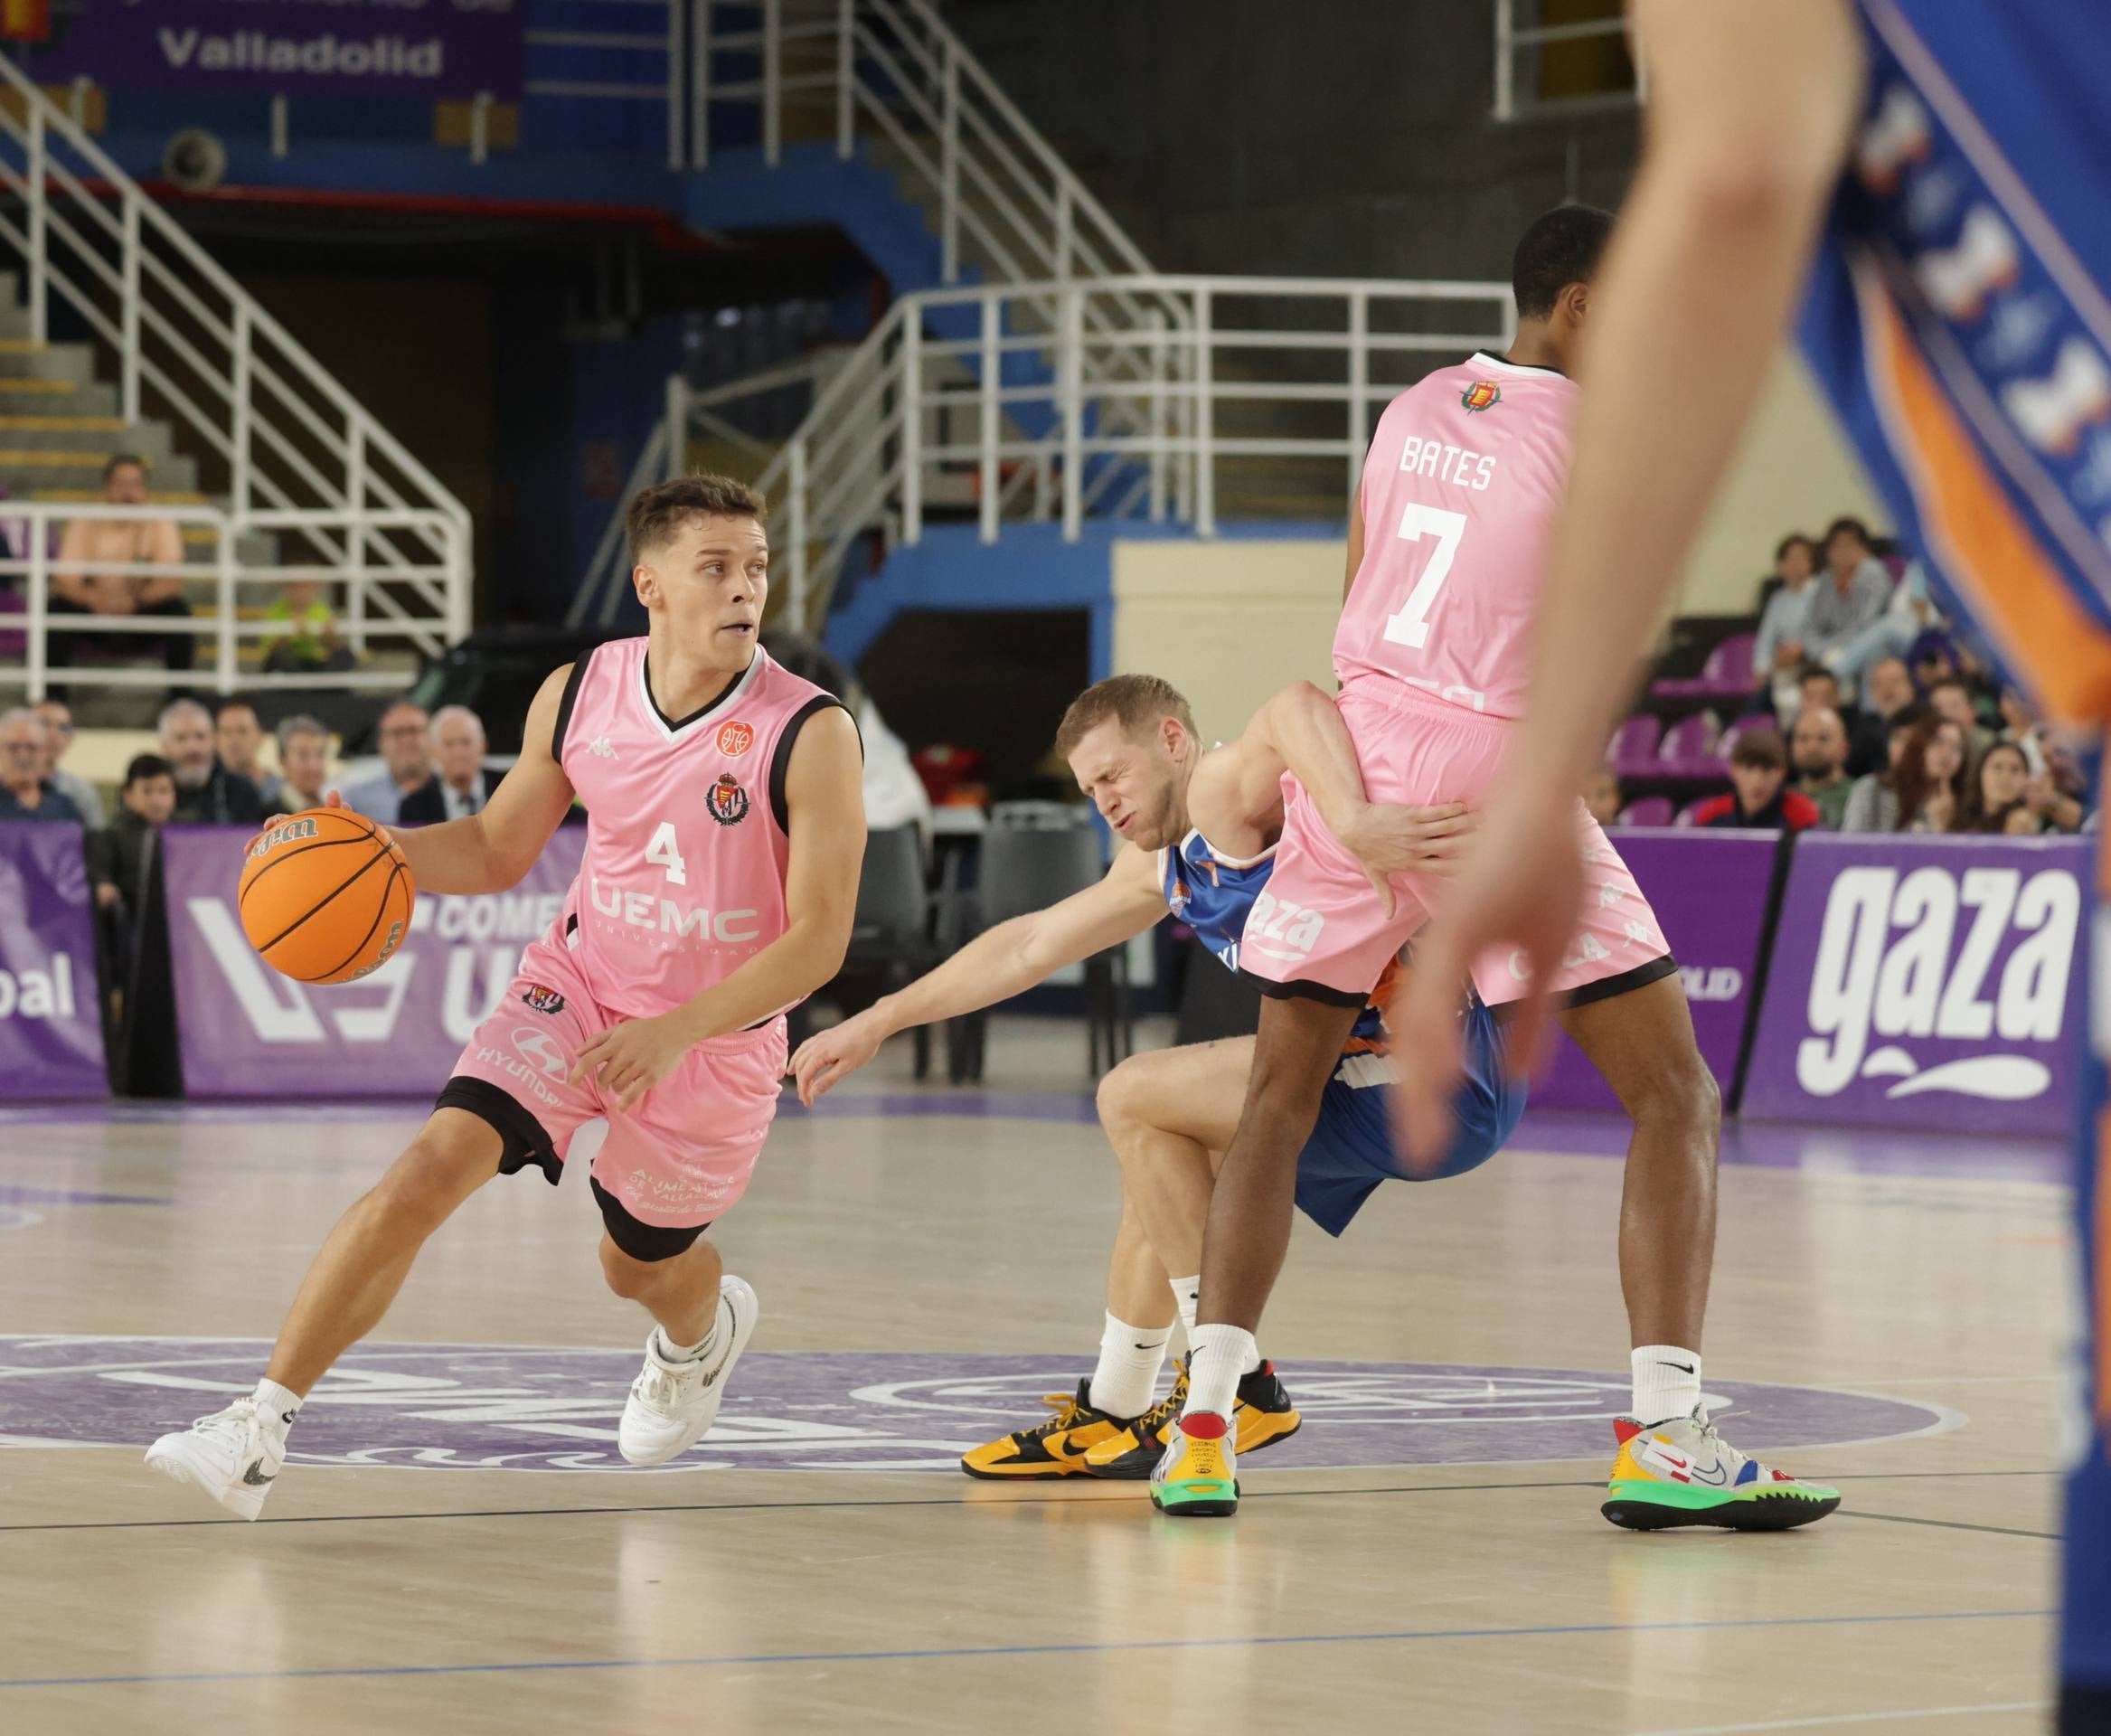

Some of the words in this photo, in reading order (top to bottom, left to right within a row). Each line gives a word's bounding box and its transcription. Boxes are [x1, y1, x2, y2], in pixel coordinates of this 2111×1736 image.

[157, 27, 445, 78] Valladolid
[1399, 435, 1496, 491] BATES
[1382, 502, 1468, 649] 7
[246, 816, 319, 862] Wil
[645, 821, 686, 886] 4
[591, 877, 760, 942] UEMC
[1795, 865, 2081, 1097] gaza
